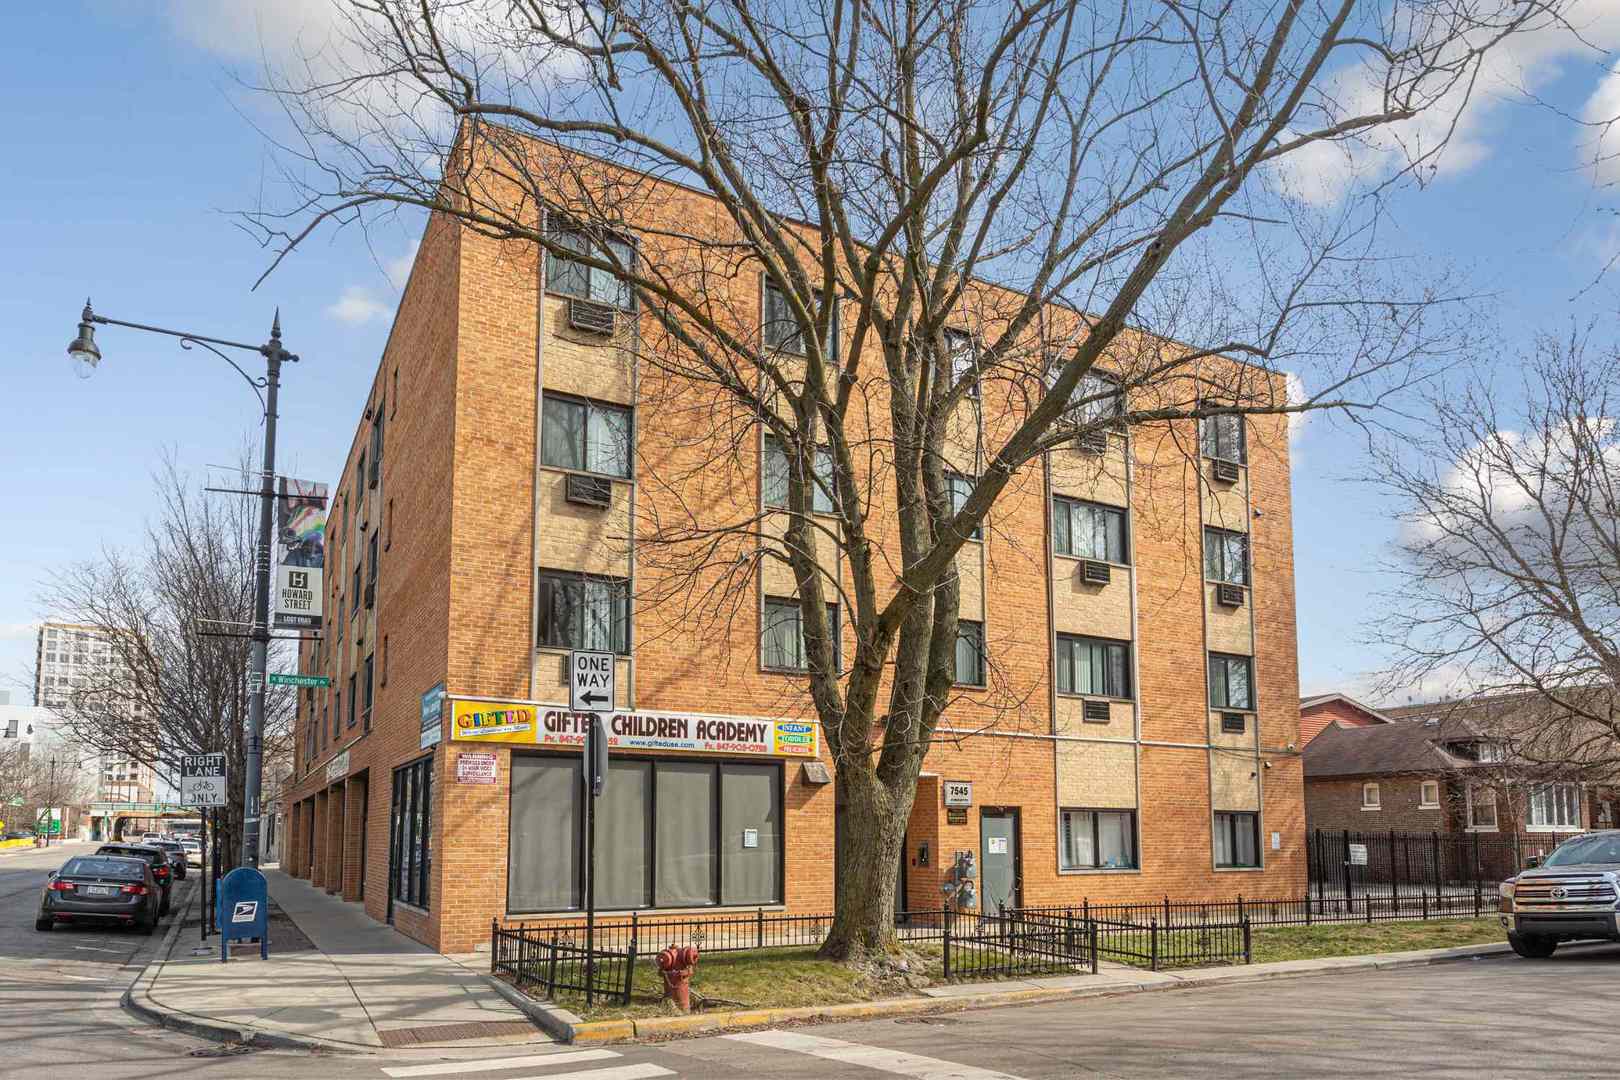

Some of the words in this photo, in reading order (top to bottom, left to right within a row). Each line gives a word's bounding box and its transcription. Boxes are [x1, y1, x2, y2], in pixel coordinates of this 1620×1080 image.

[282, 588, 313, 601] HOWARD
[284, 599, 312, 610] STREET
[578, 656, 610, 671] ONE
[278, 677, 317, 686] Winchester
[577, 673, 610, 688] WAY
[458, 709, 532, 728] GIFTED
[544, 711, 601, 735] GIFTE
[611, 715, 688, 739] CHILDREN
[696, 720, 768, 742] ACADEMY
[783, 724, 807, 732] INFANT
[184, 756, 223, 767] RIGHT
[186, 766, 220, 777] LANE
[950, 786, 968, 796] 7545
